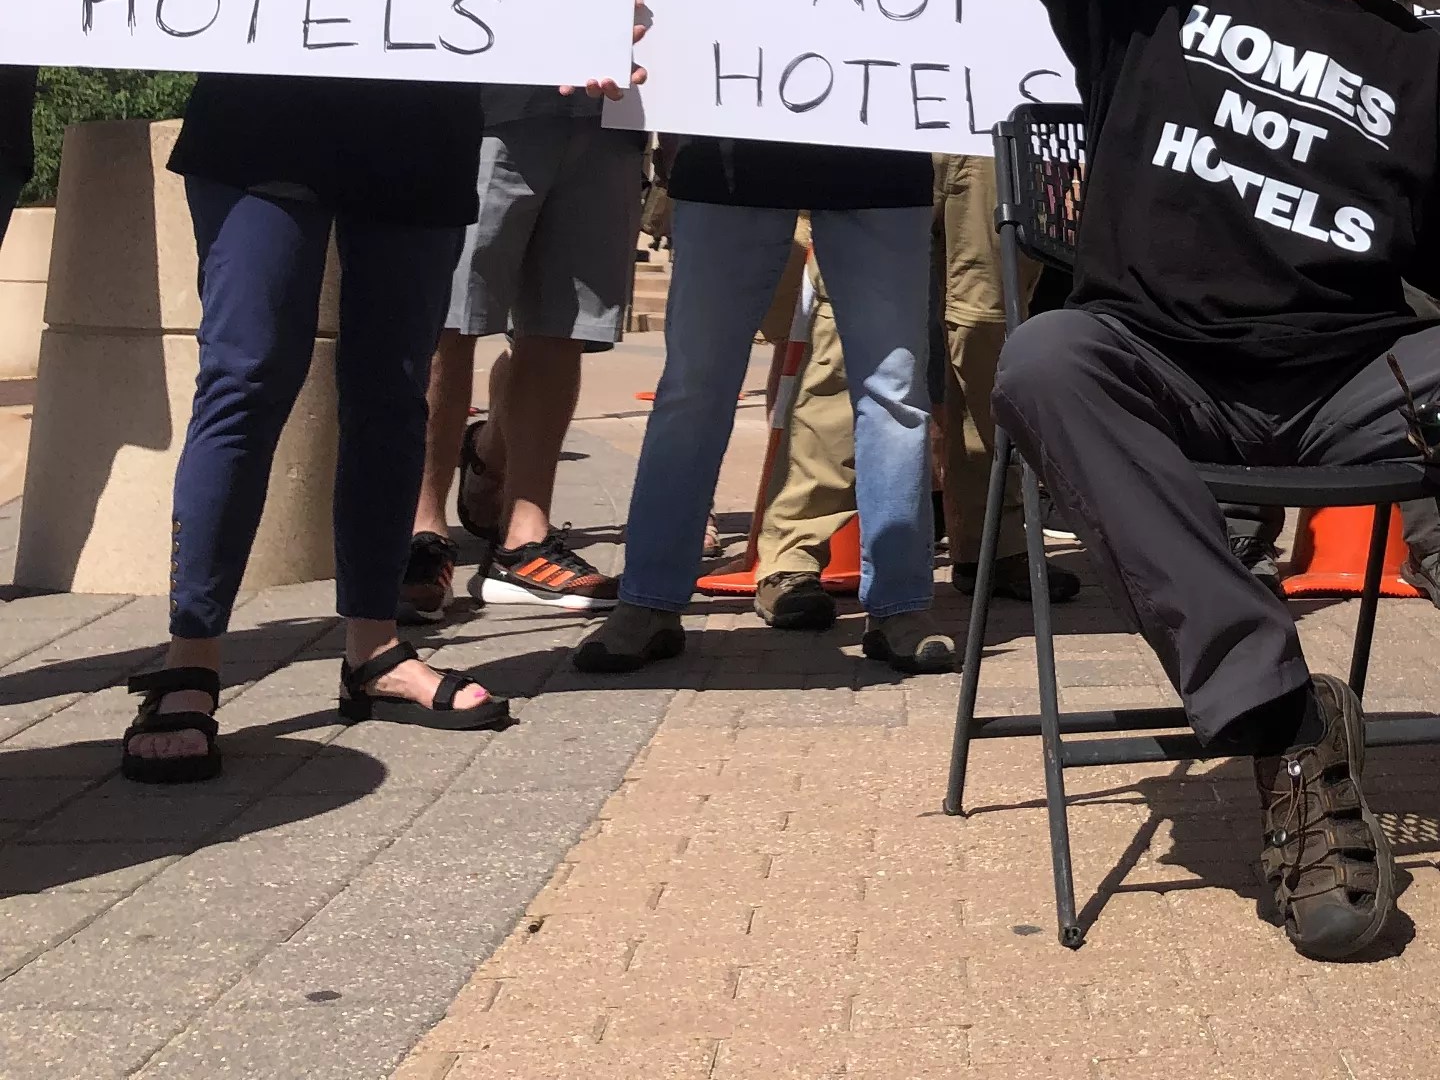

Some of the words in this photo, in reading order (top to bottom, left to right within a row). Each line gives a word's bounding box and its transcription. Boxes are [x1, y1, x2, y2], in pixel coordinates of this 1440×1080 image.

[1179, 4, 1397, 137] HOMES
[1213, 88, 1329, 163] NOT
[1151, 122, 1376, 253] HOTELS
